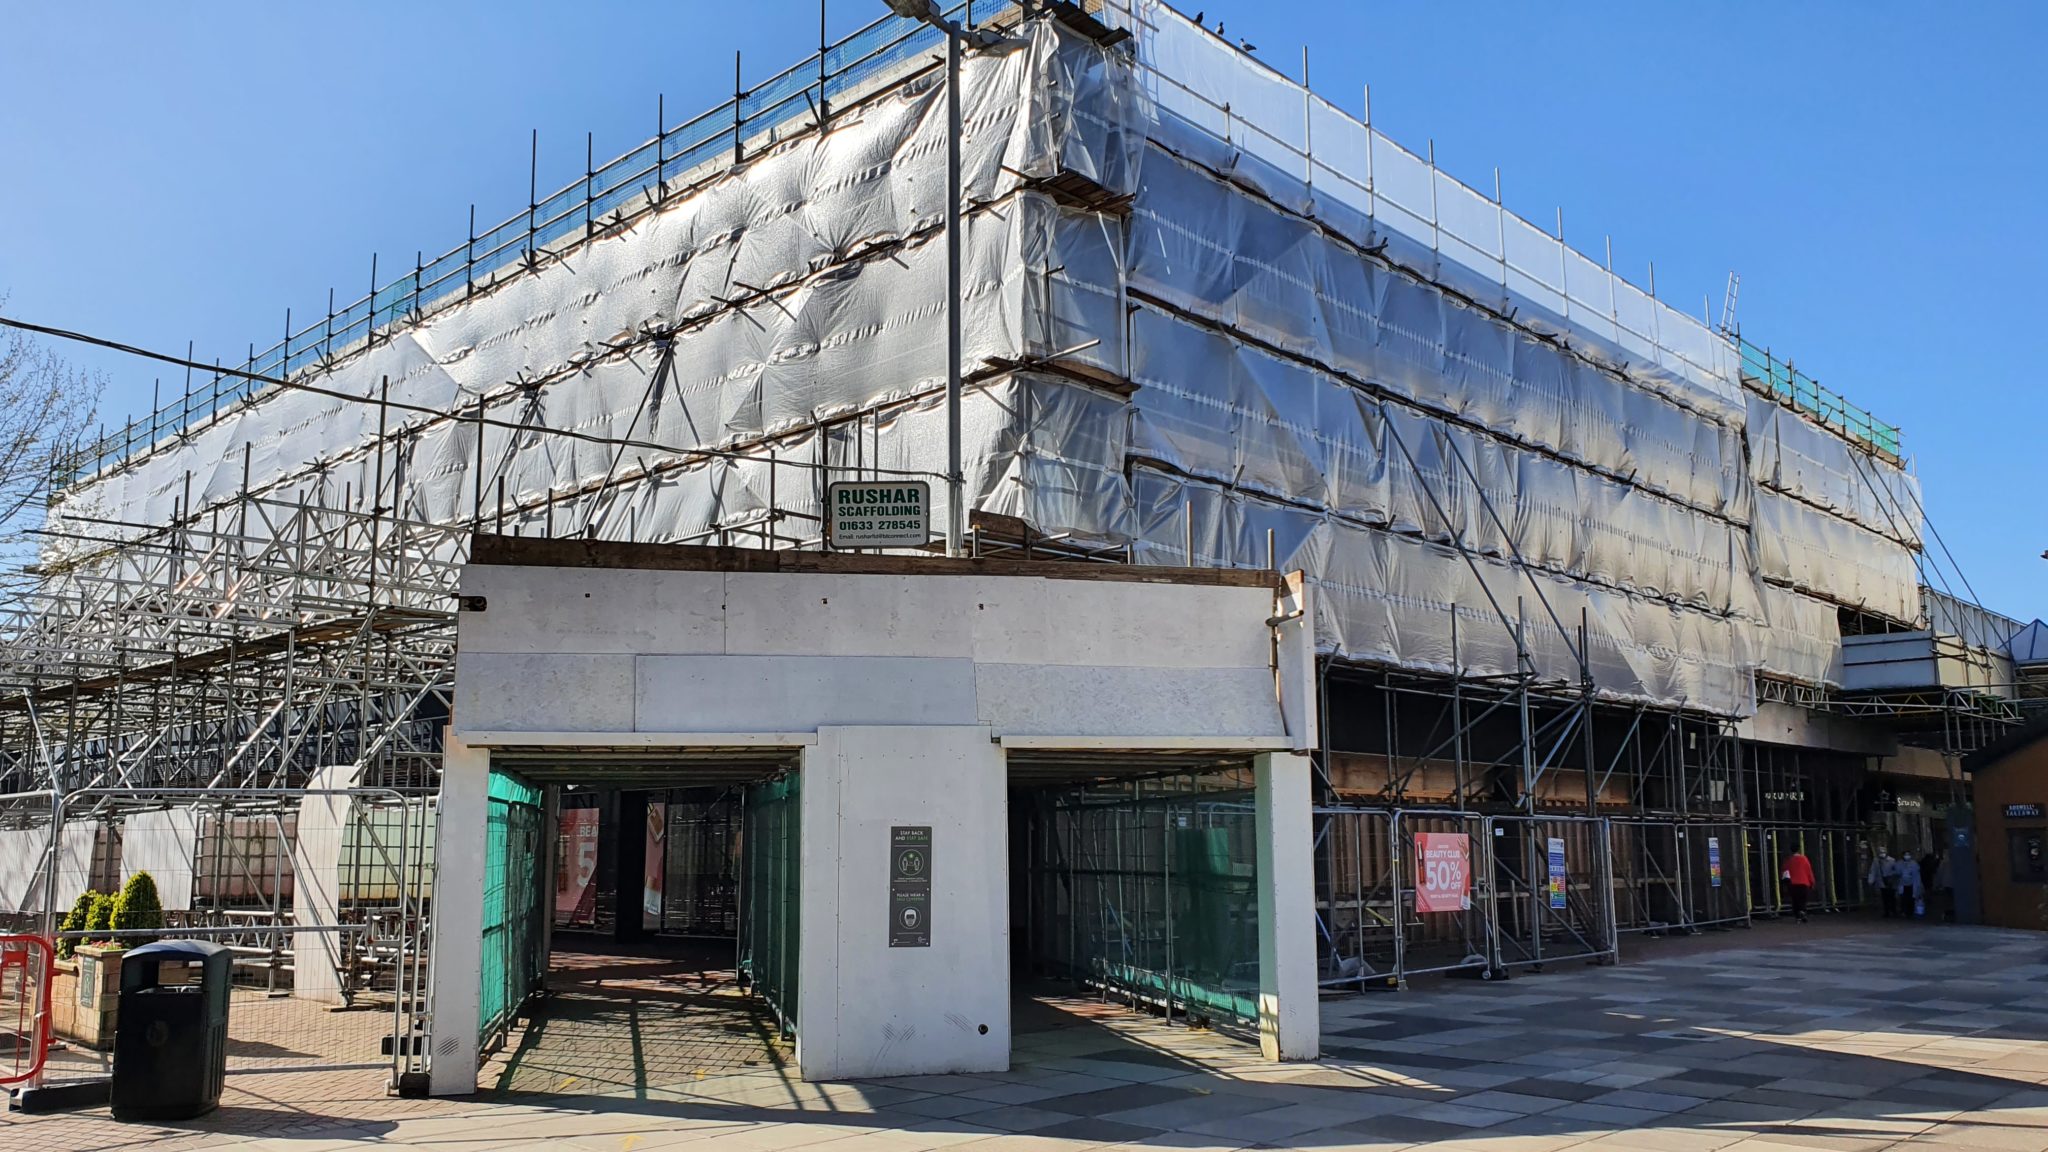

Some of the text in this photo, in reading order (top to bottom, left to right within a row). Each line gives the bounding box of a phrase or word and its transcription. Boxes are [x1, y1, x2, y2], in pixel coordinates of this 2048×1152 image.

[838, 489, 920, 504] RUSHAR
[838, 505, 921, 517] SCAFFOLDING
[839, 520, 921, 530] 01633 278545
[1426, 850, 1447, 858] BEAUTY
[1426, 861, 1461, 891] 50%
[1450, 882, 1461, 890] OFF
